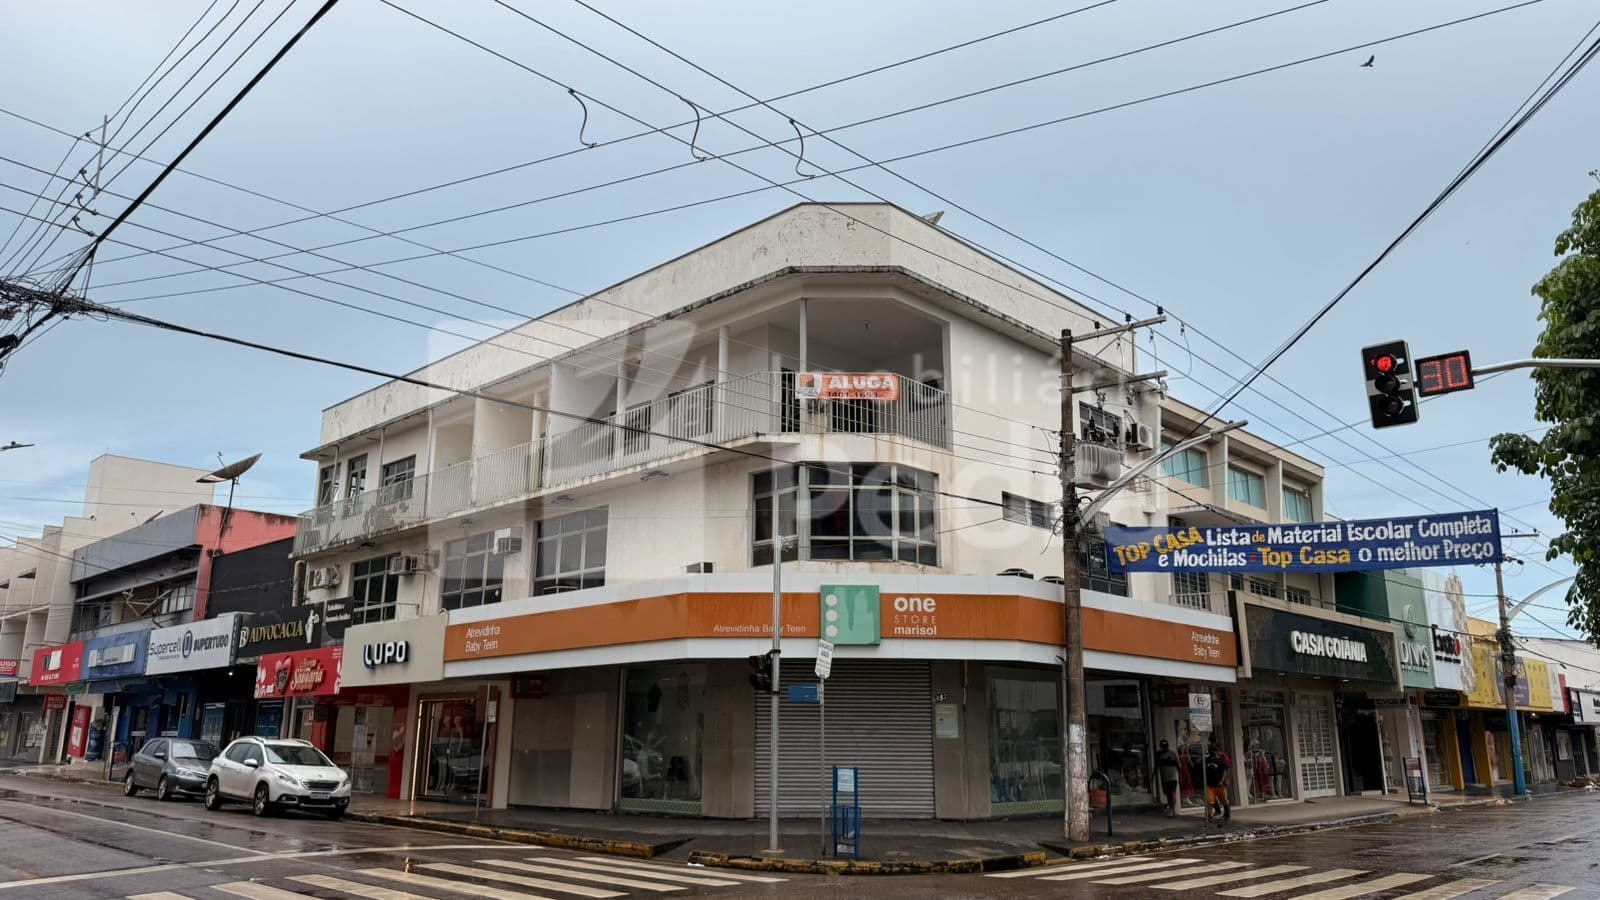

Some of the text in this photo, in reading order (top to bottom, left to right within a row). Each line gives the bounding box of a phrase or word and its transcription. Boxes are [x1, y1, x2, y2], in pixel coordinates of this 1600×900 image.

[829, 375, 895, 390] ALUGA
[1422, 356, 1470, 393] 30
[1206, 515, 1492, 546] Lista de Material Escolar Completa
[1113, 527, 1204, 566] TOP CASA
[1158, 555, 1169, 567] e
[1173, 549, 1247, 567] Mochilas
[1257, 547, 1293, 568] Top
[1300, 547, 1351, 565] Casa
[1358, 547, 1372, 562] o
[1377, 542, 1438, 562] melhor
[1443, 540, 1495, 560] Preço
[894, 597, 936, 613] one
[894, 614, 937, 624] STORE
[250, 620, 304, 642] ADVOCACIA
[465, 624, 501, 638] Atrevidinha
[713, 624, 806, 635] Atrevidinha Bay Teen
[894, 625, 937, 636] marisol
[193, 634, 229, 651] SUPERTUDO
[465, 639, 499, 654] Baby Teen
[1291, 630, 1325, 656] CASA
[365, 640, 406, 666] LUPO
